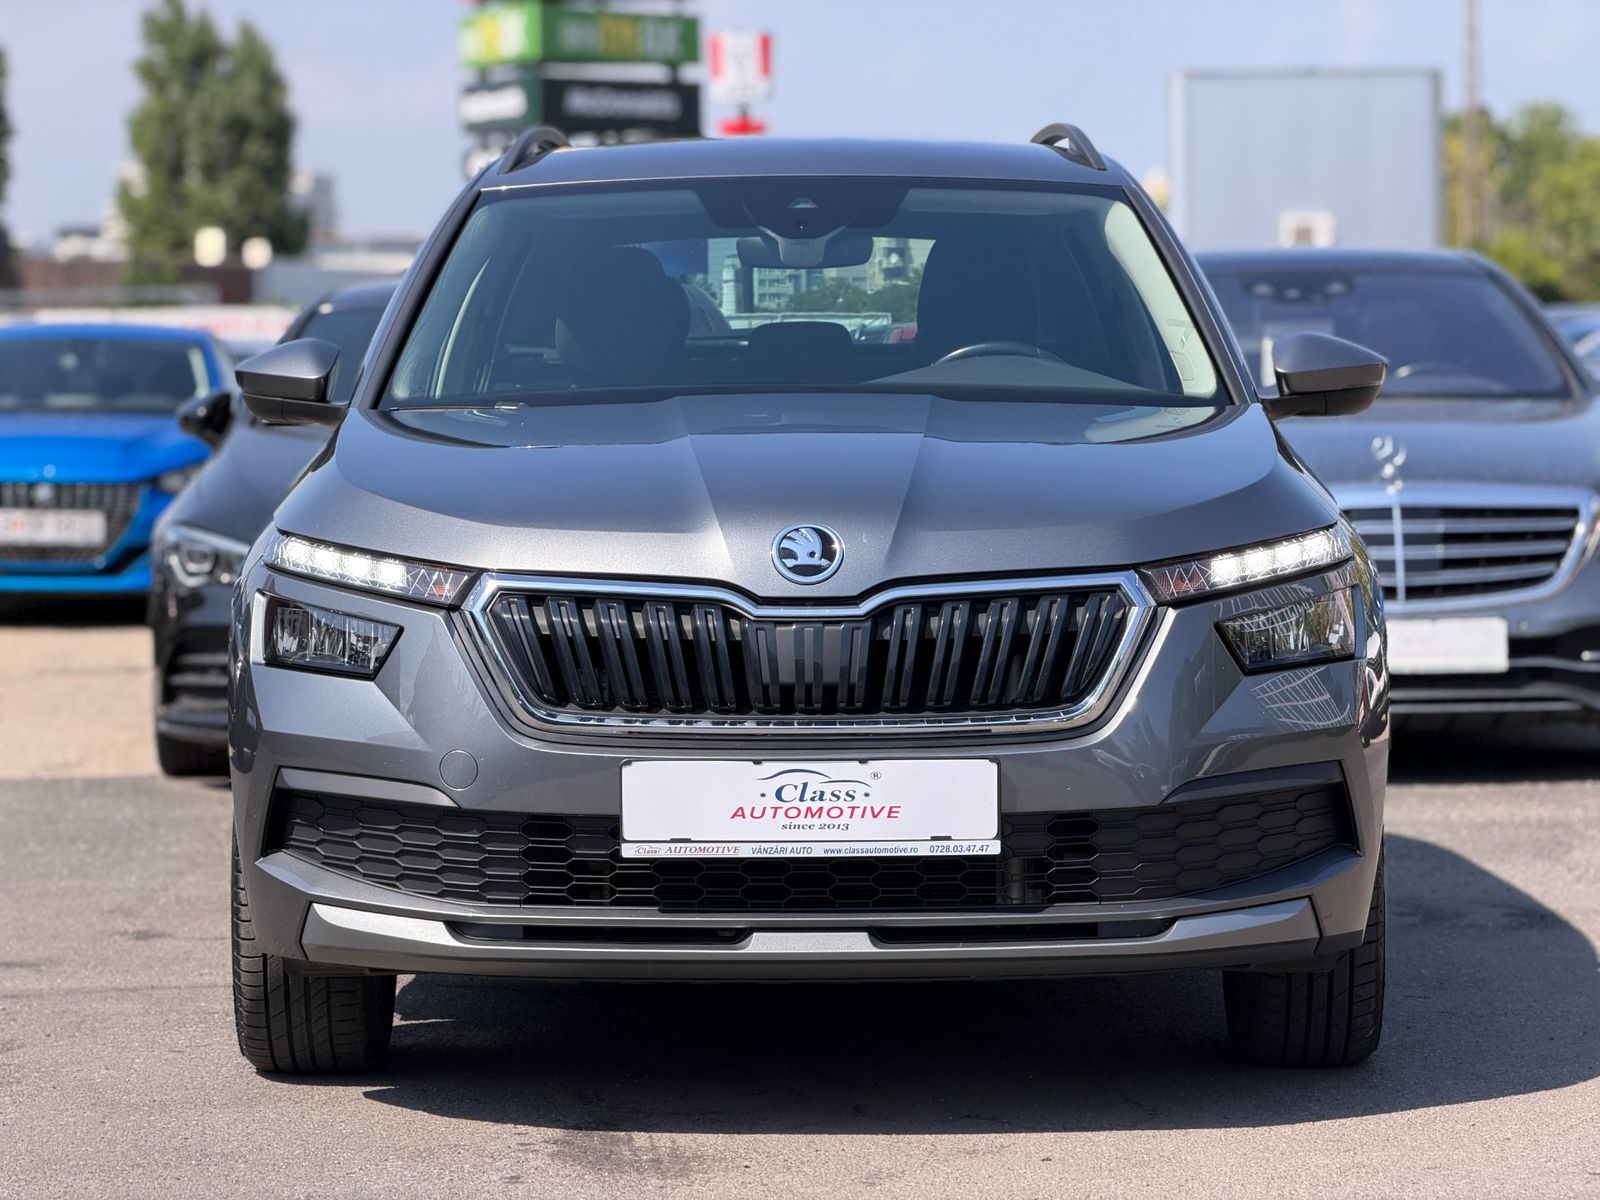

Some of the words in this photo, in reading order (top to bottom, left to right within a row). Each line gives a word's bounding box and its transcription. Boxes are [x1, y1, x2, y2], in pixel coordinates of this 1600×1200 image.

[775, 782, 856, 803] Class
[730, 805, 902, 820] AUTOMOTIVE
[781, 821, 816, 831] since
[818, 822, 850, 831] 2013
[664, 845, 740, 855] AUTOMOTIVE
[789, 847, 813, 855] AUTO
[823, 846, 919, 855] www.classautomotive.ro
[929, 844, 990, 854] 0728.03.47.47
